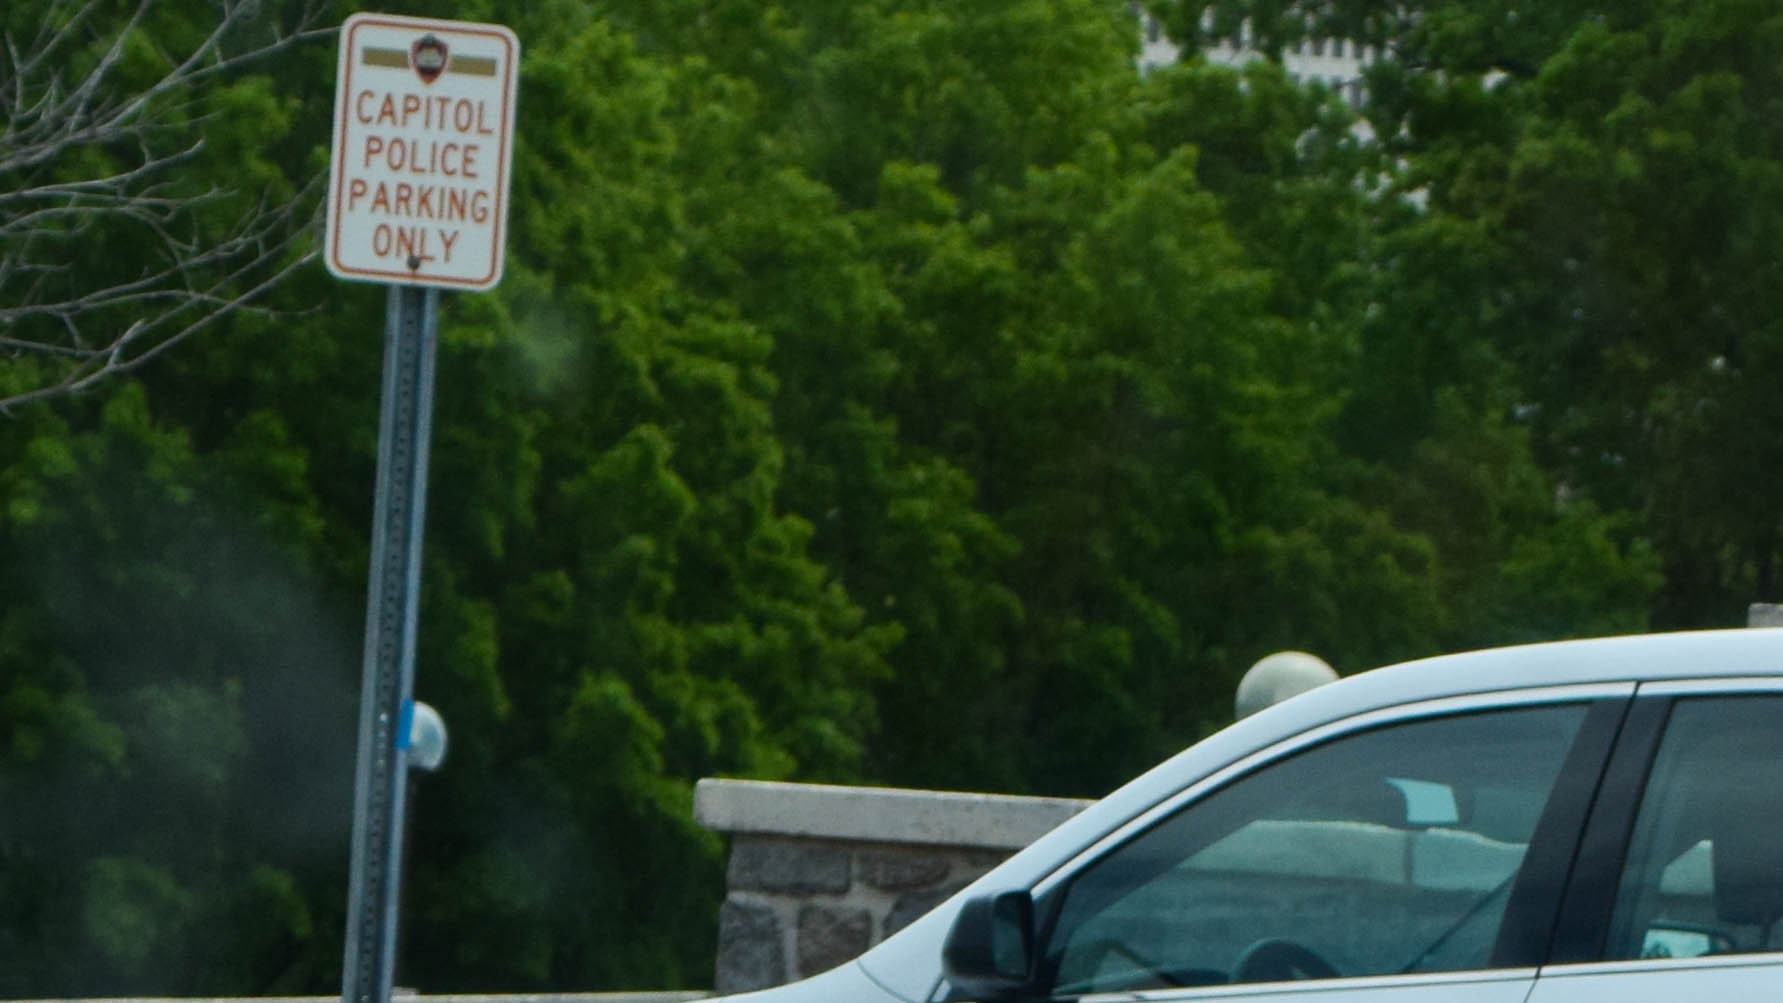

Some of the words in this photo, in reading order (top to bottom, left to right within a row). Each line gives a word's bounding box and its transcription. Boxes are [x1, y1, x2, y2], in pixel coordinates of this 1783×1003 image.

[355, 90, 494, 135] CAPITOL
[364, 135, 479, 178] POLICE
[348, 178, 489, 224] PARKING
[372, 223, 459, 262] ONLY
